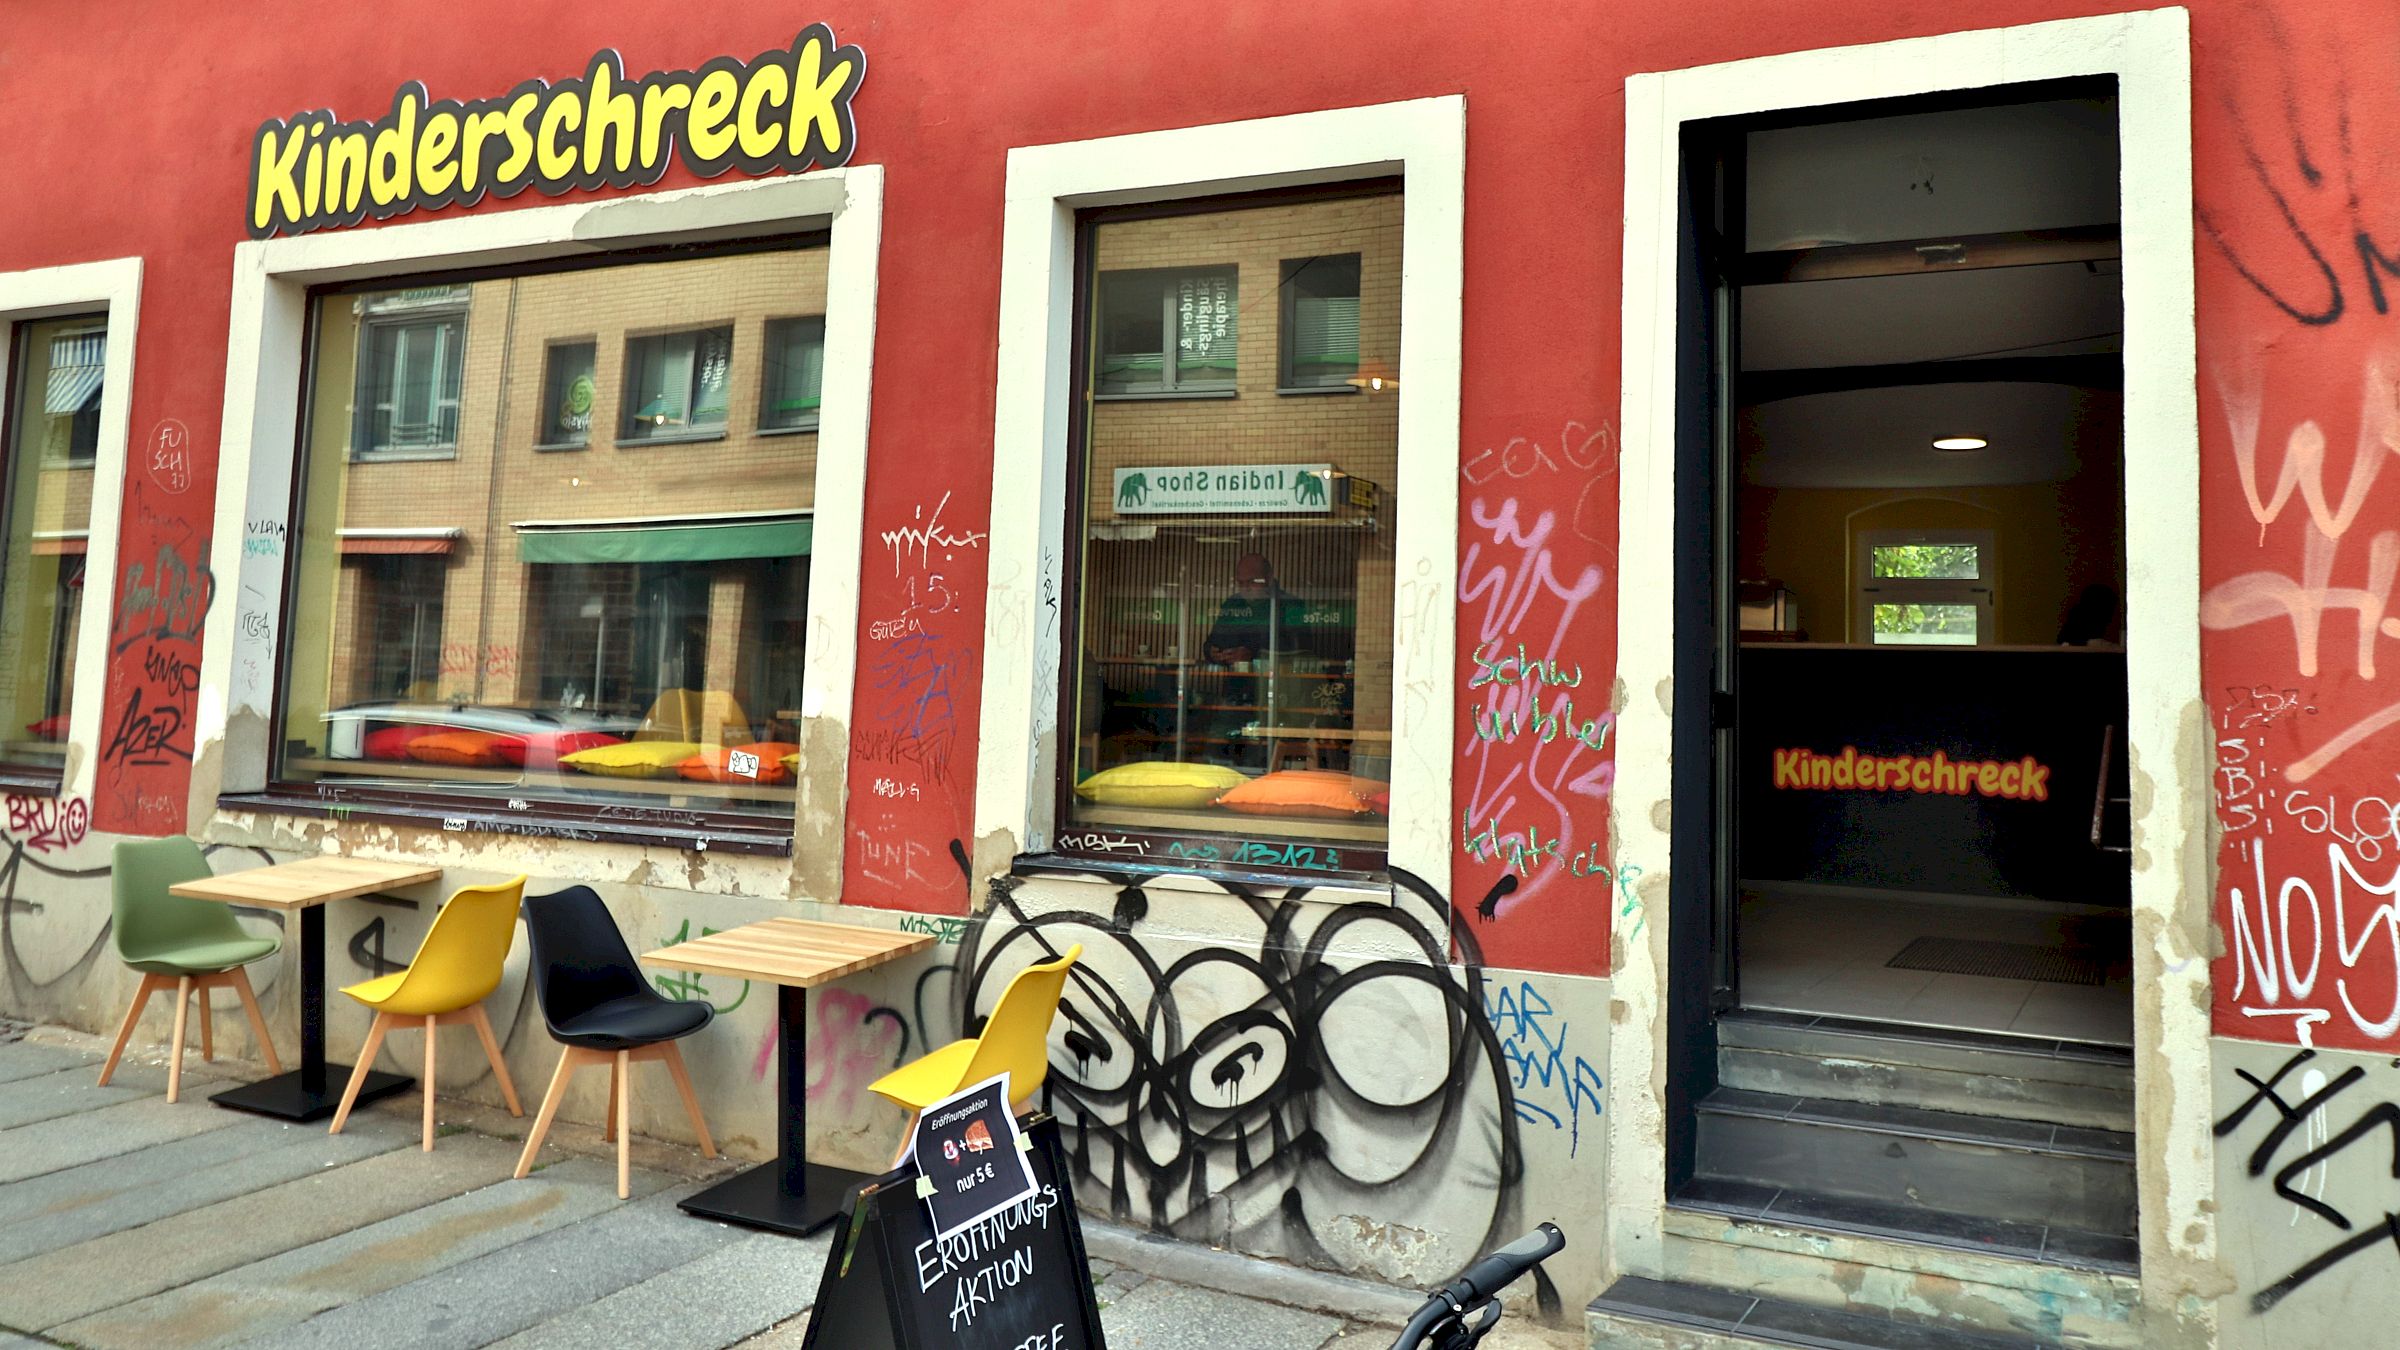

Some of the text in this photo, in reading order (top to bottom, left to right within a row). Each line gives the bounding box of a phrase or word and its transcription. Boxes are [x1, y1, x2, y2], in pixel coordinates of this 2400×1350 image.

[254, 39, 852, 229] Kinderschreck
[1776, 750, 2046, 798] Kinderschreck
[931, 1098, 988, 1130] Eröffnungsaktion
[956, 1173, 975, 1193] nur
[950, 1245, 1033, 1332] AKTION
